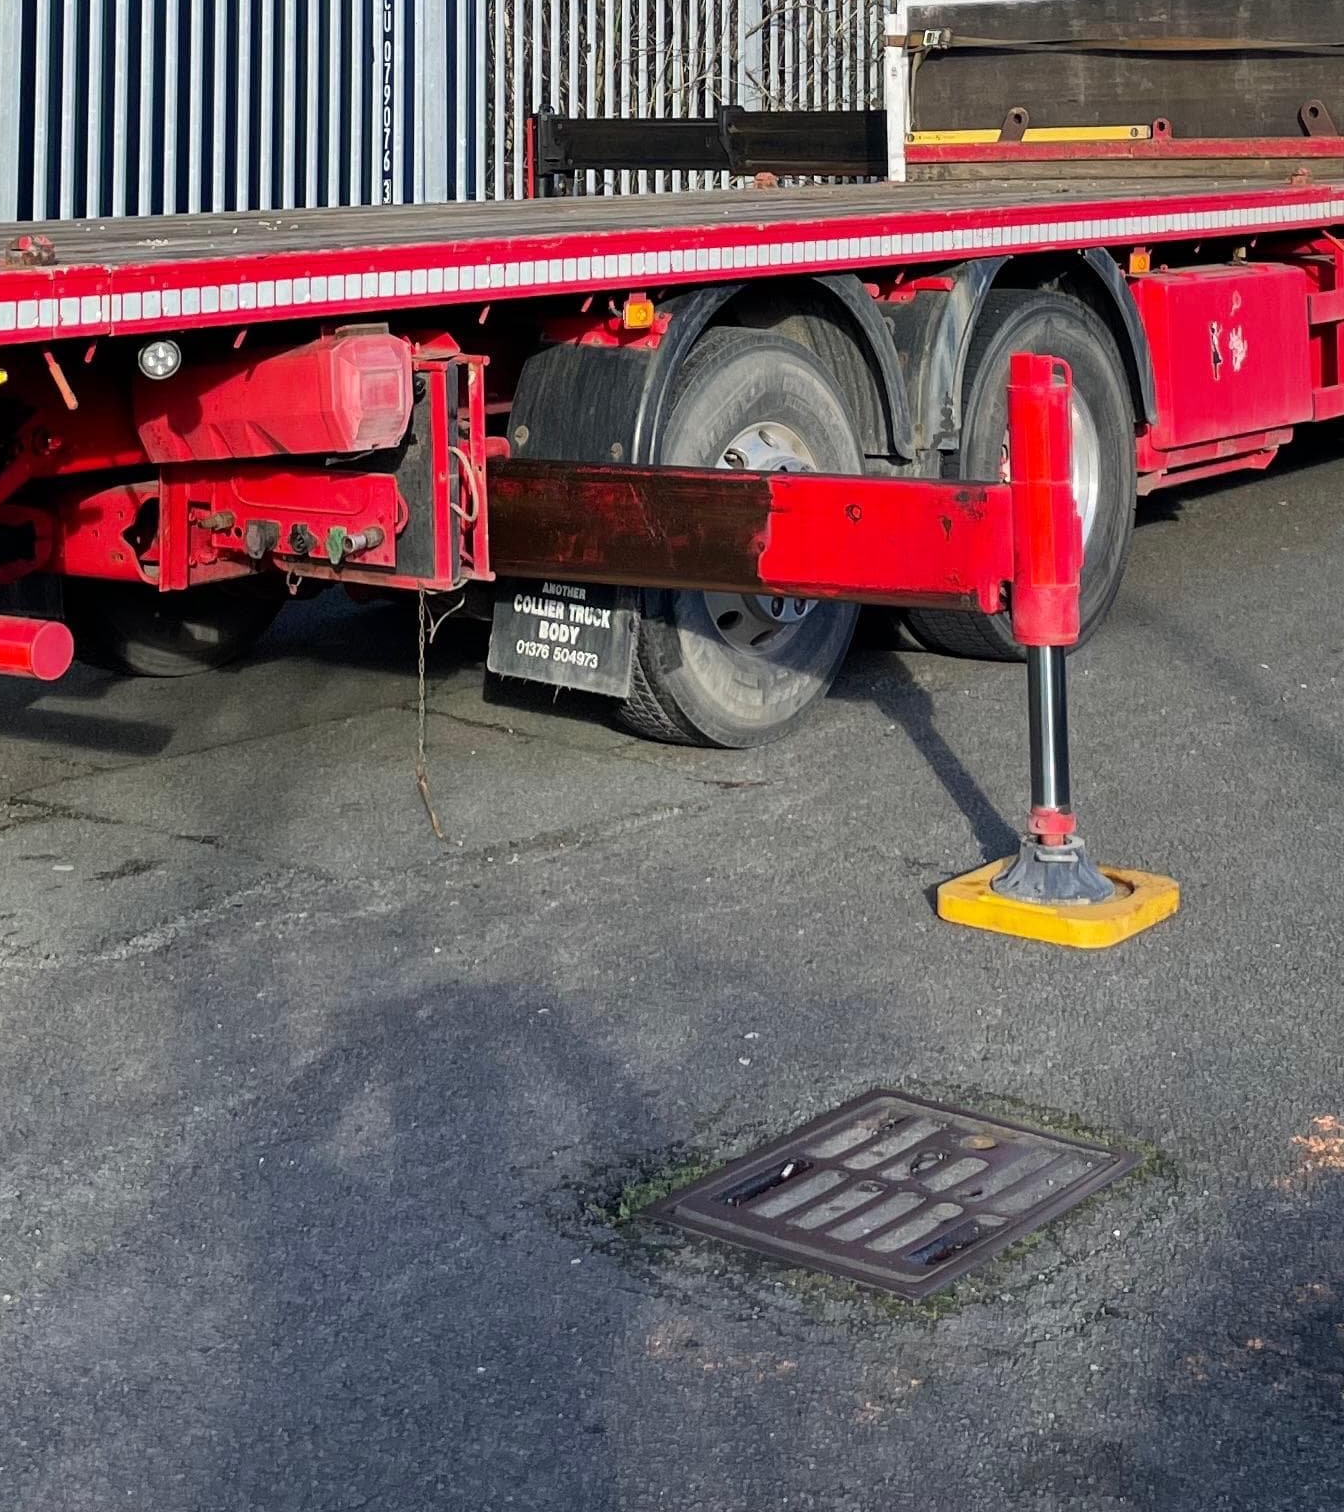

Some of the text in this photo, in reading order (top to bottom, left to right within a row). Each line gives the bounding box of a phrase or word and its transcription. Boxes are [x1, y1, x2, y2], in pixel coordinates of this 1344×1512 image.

[542, 582, 586, 600] ANOTHER
[514, 594, 611, 628] COLLIER TRUCK
[538, 620, 580, 645] BODY
[516, 640, 598, 669] 01376 504973
